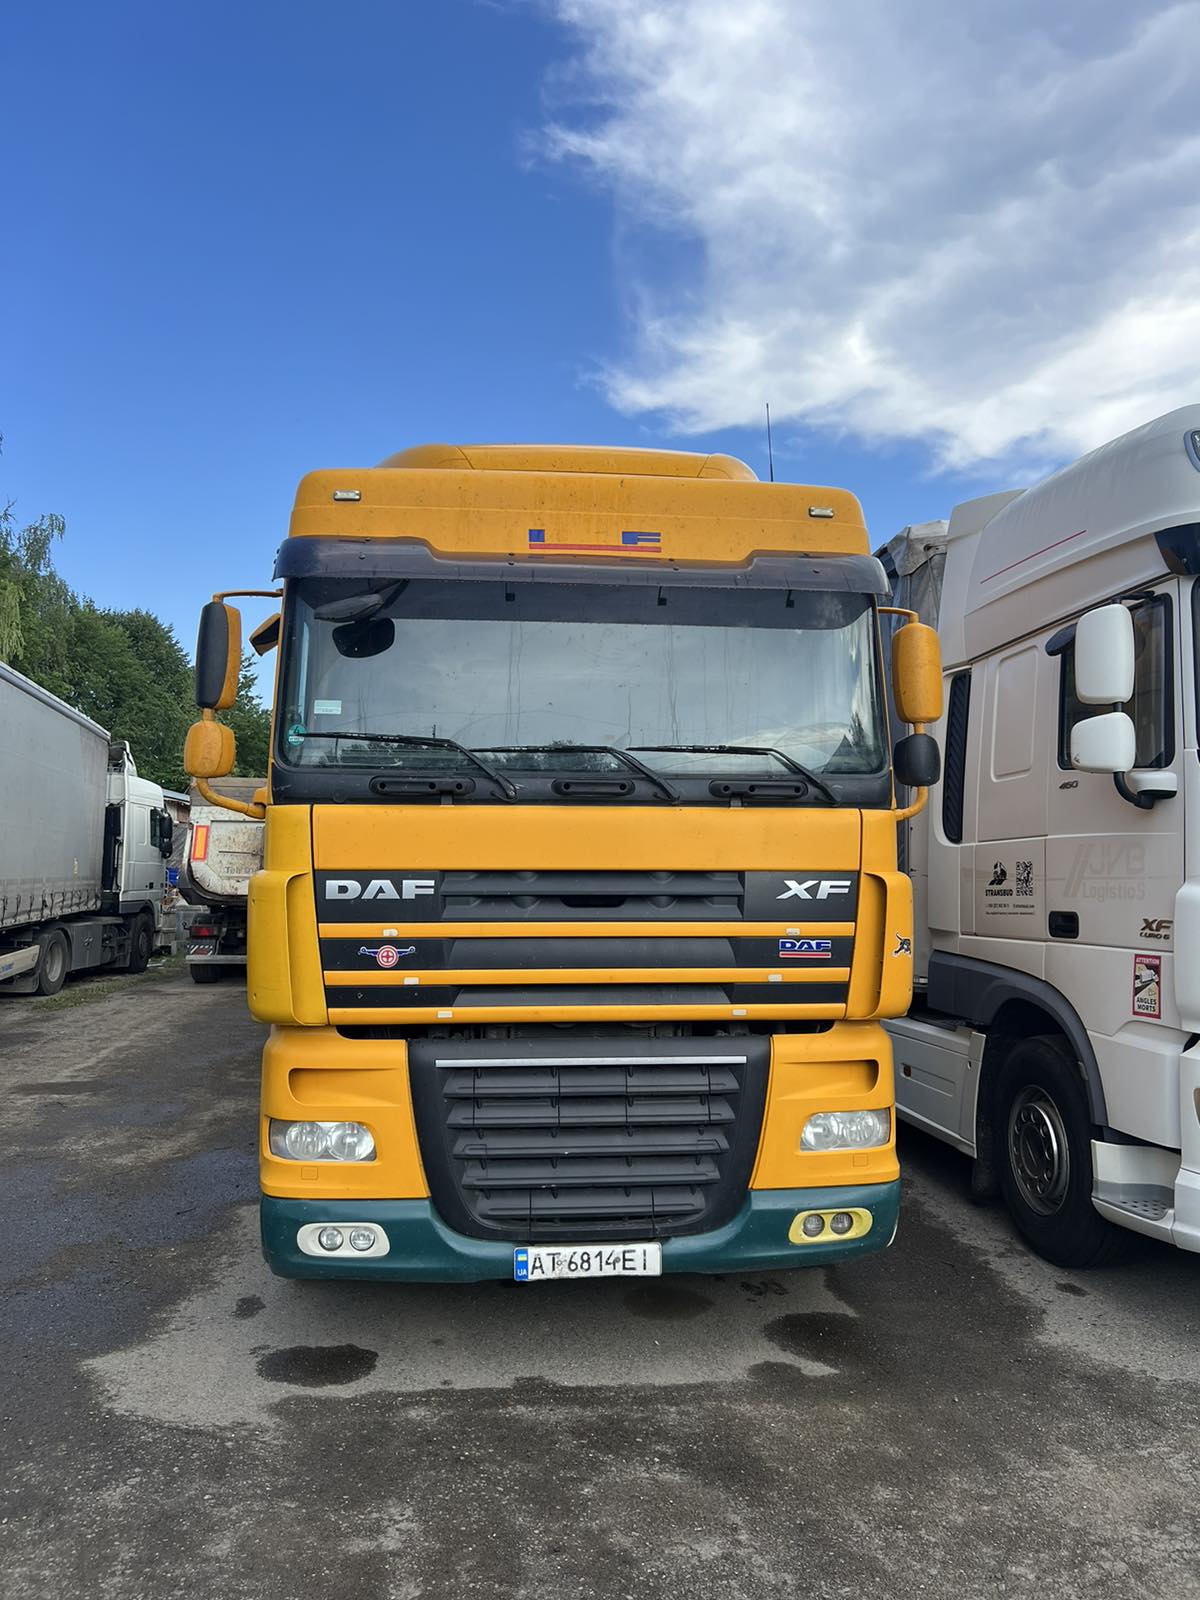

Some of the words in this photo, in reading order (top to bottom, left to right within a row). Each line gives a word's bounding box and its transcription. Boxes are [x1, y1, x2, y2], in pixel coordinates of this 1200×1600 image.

[1059, 780, 1079, 789] 460
[325, 879, 436, 900] DAF
[775, 880, 852, 900] XF
[1140, 918, 1174, 932] XF
[779, 939, 832, 951] DAF
[1136, 996, 1157, 1006] ANGLES
[1137, 1004, 1156, 1013] MORTS
[517, 1268, 527, 1277] UA
